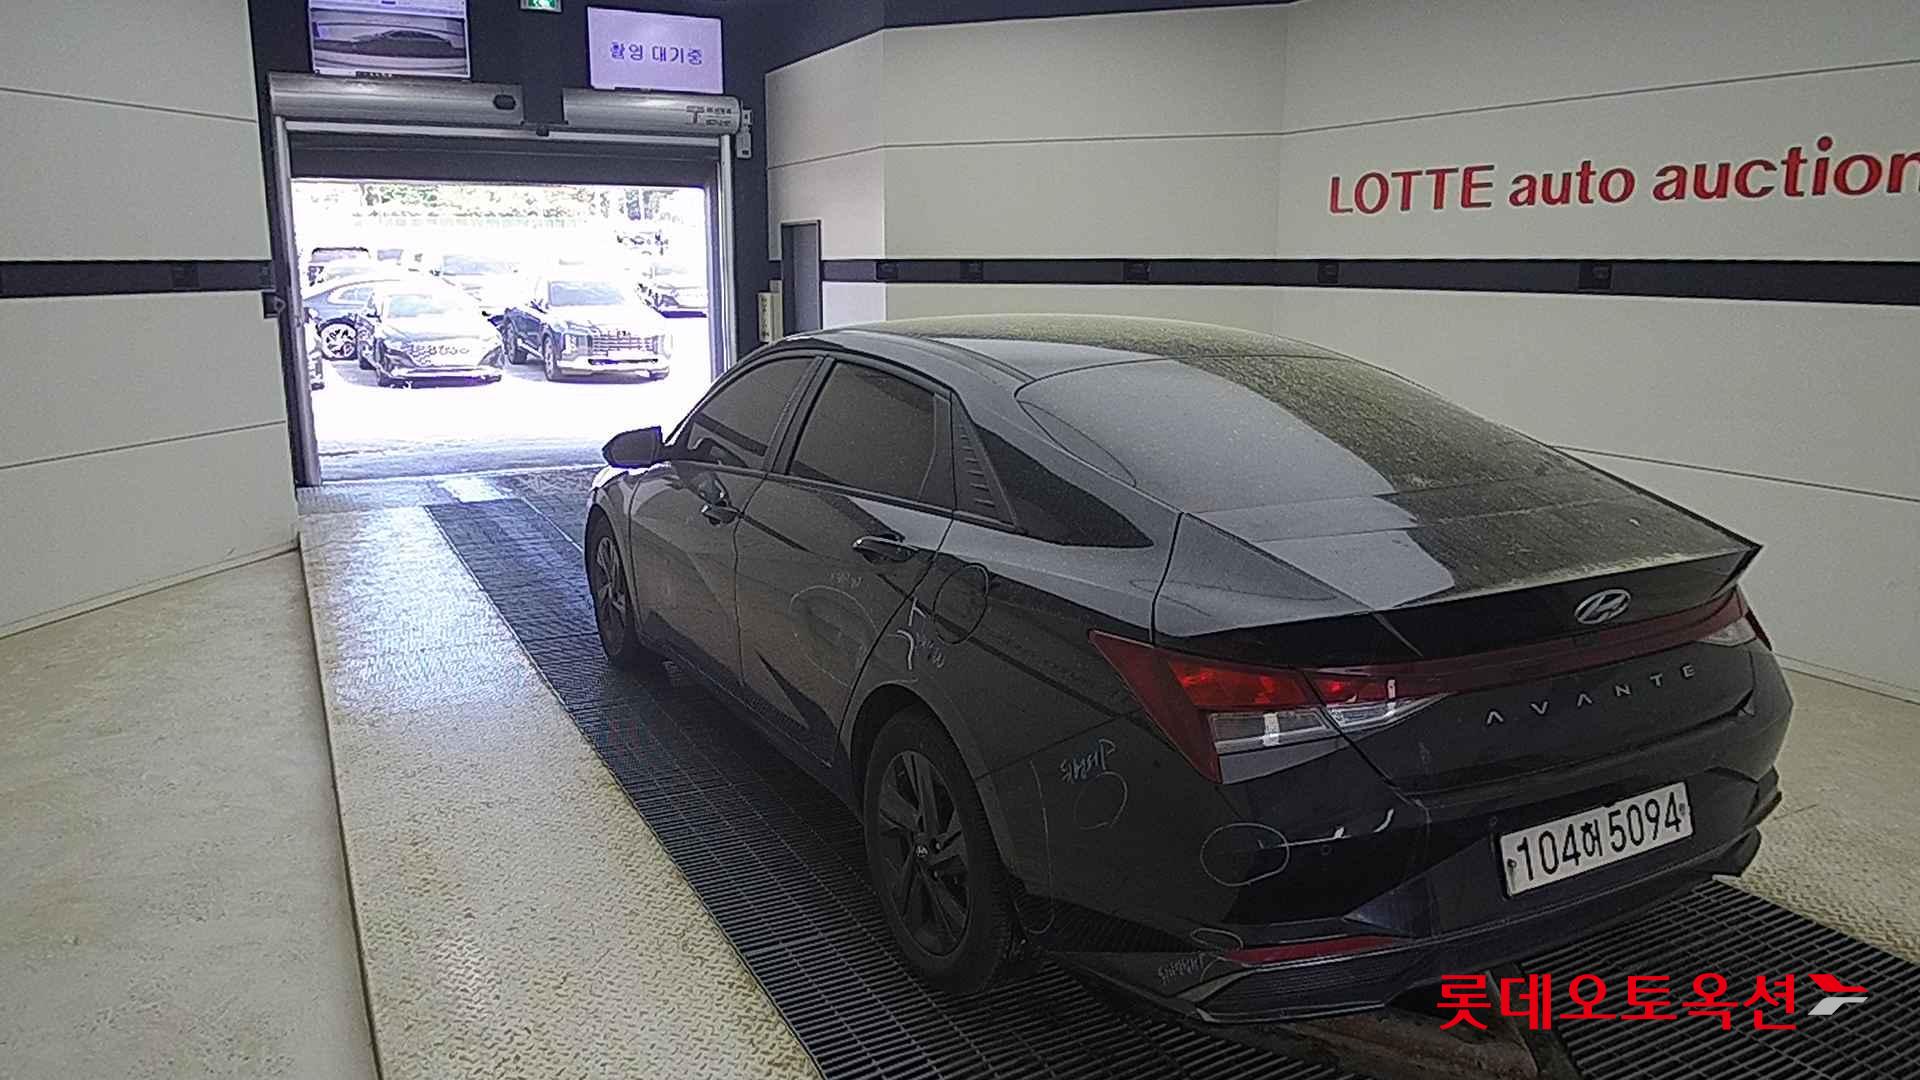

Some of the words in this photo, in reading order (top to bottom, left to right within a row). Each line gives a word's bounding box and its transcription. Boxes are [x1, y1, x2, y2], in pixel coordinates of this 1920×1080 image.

[652, 46, 702, 65] 대기중
[1329, 164, 1496, 214] LOTTE
[1508, 160, 1636, 207] auto
[1653, 135, 1920, 202] auction
[1486, 664, 1696, 725] AVANTE
[1608, 791, 1682, 853] 5094
